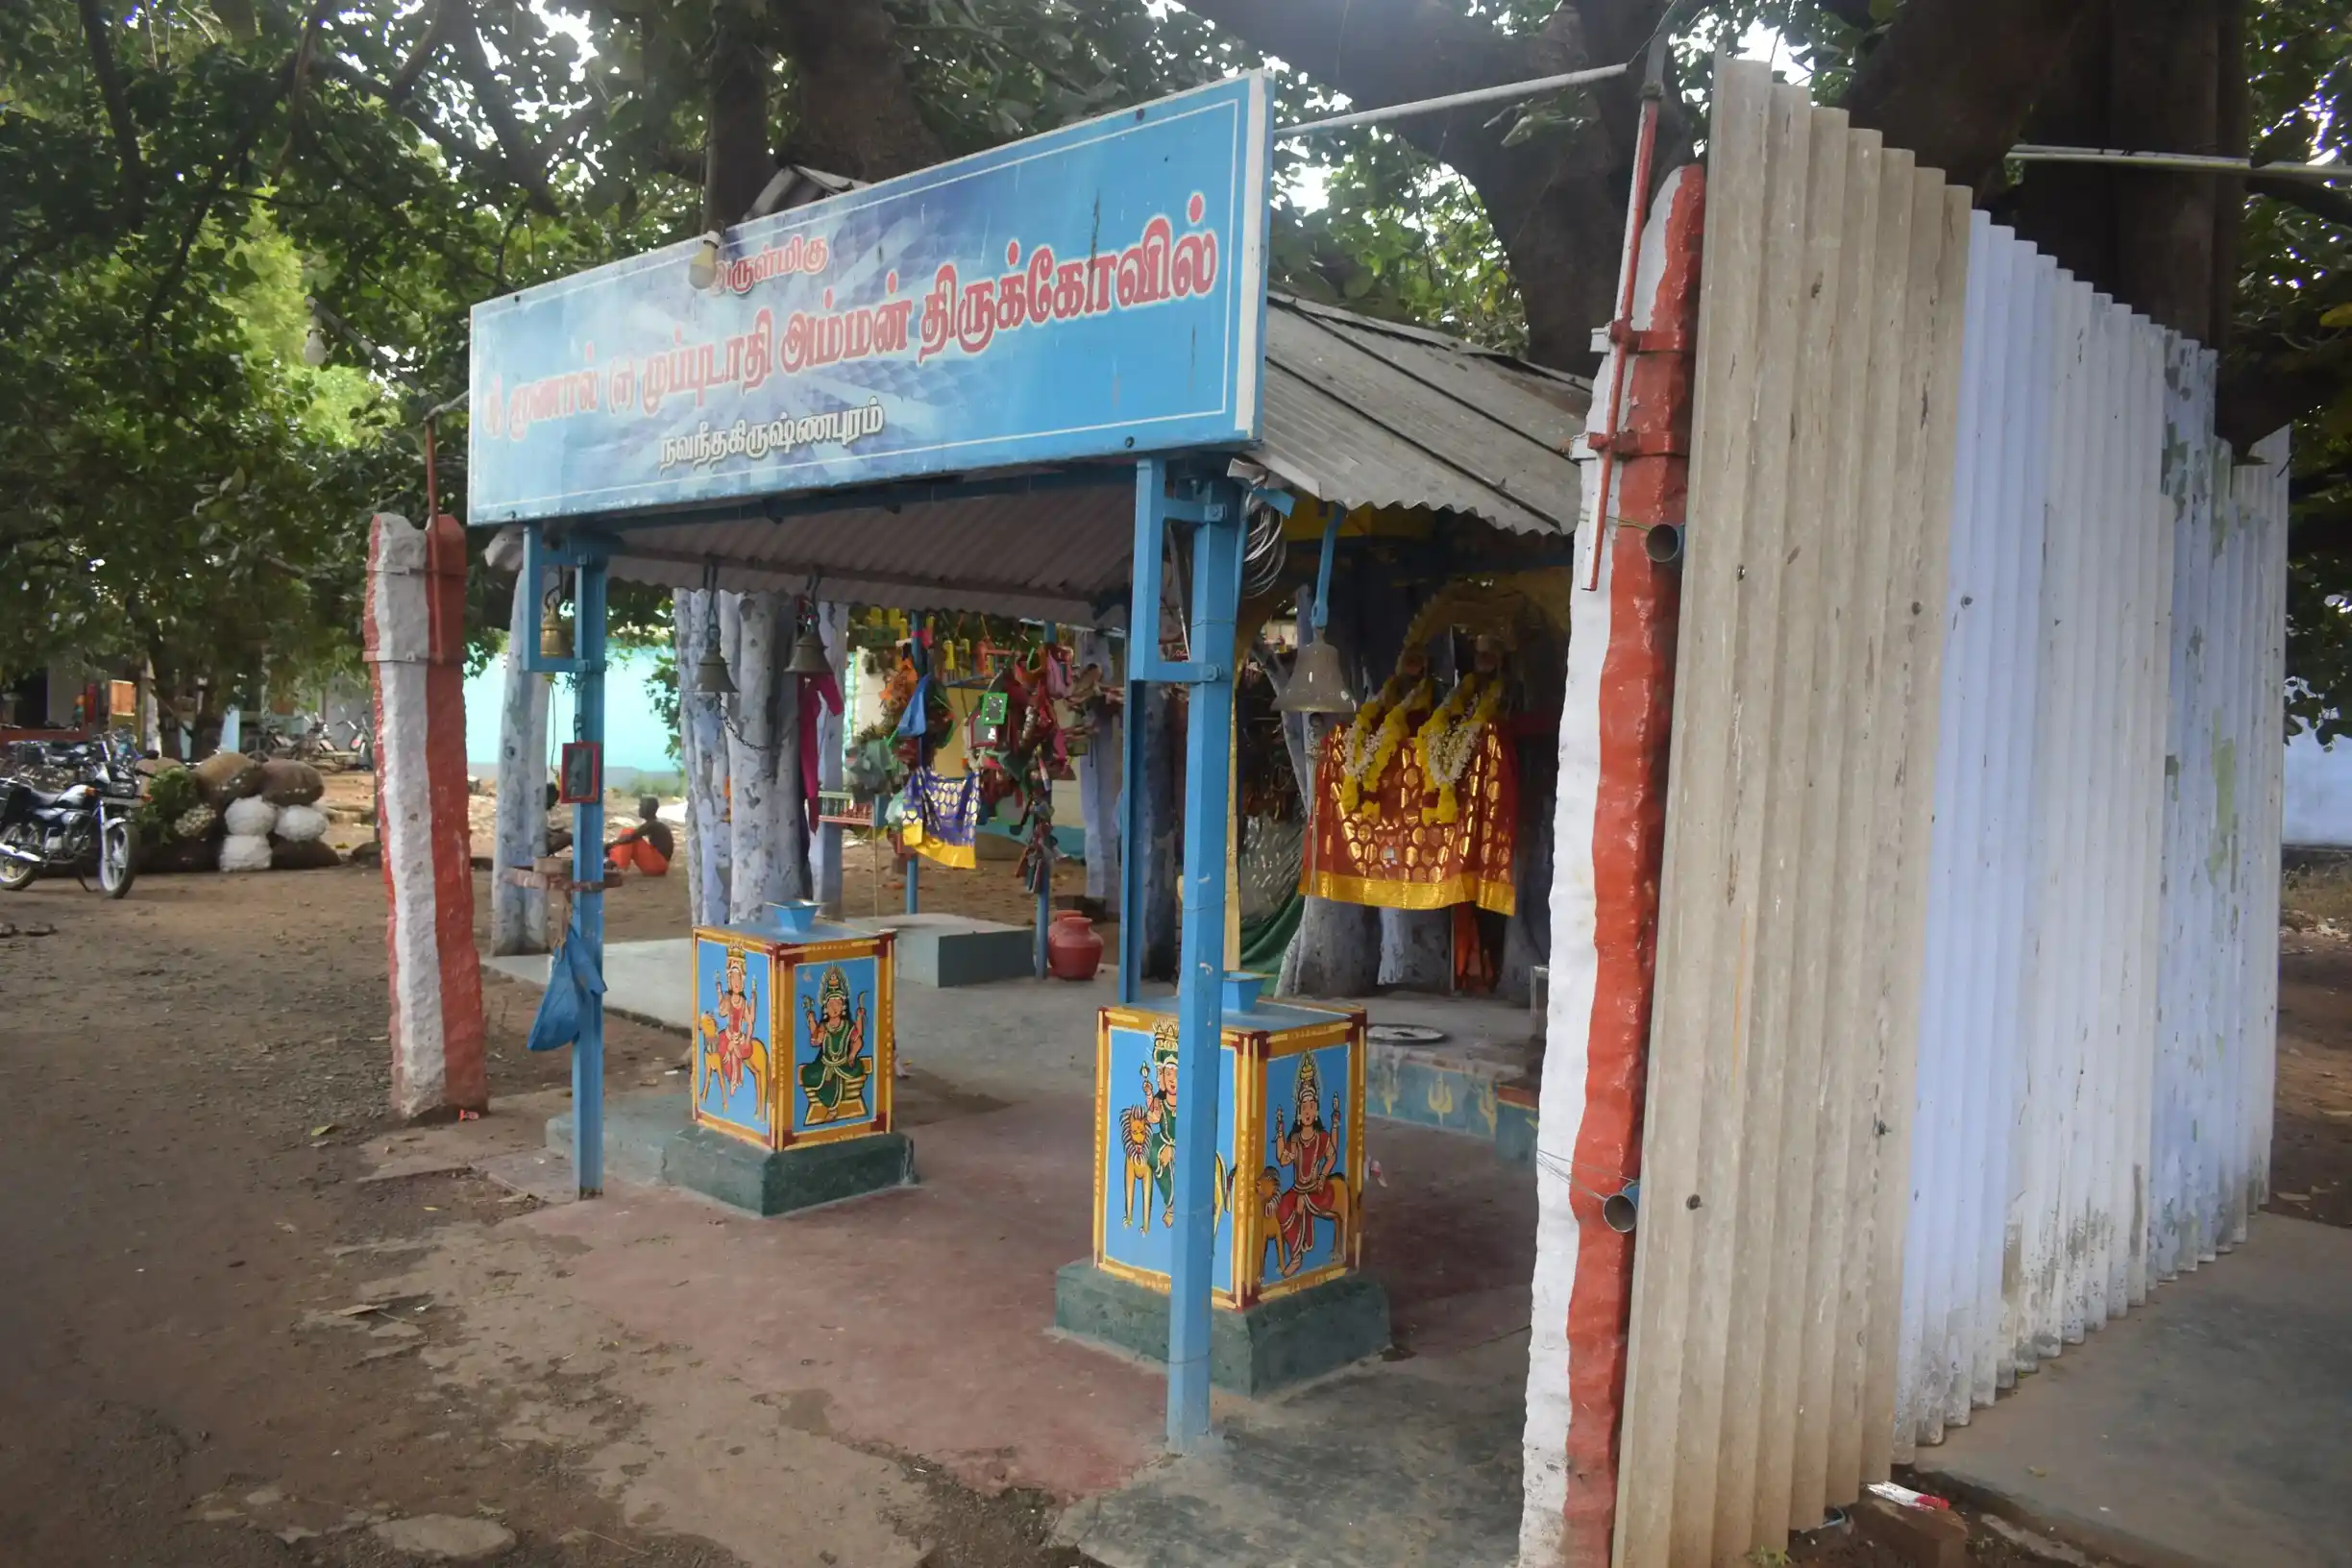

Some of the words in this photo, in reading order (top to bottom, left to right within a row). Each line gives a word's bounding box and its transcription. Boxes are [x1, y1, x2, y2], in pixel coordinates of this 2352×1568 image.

[780, 270, 912, 374] அம்மன்
[918, 192, 1218, 365] திருக்கோவில்
[660, 396, 885, 473] நவநீதகிருஷ்ணபுரம்
